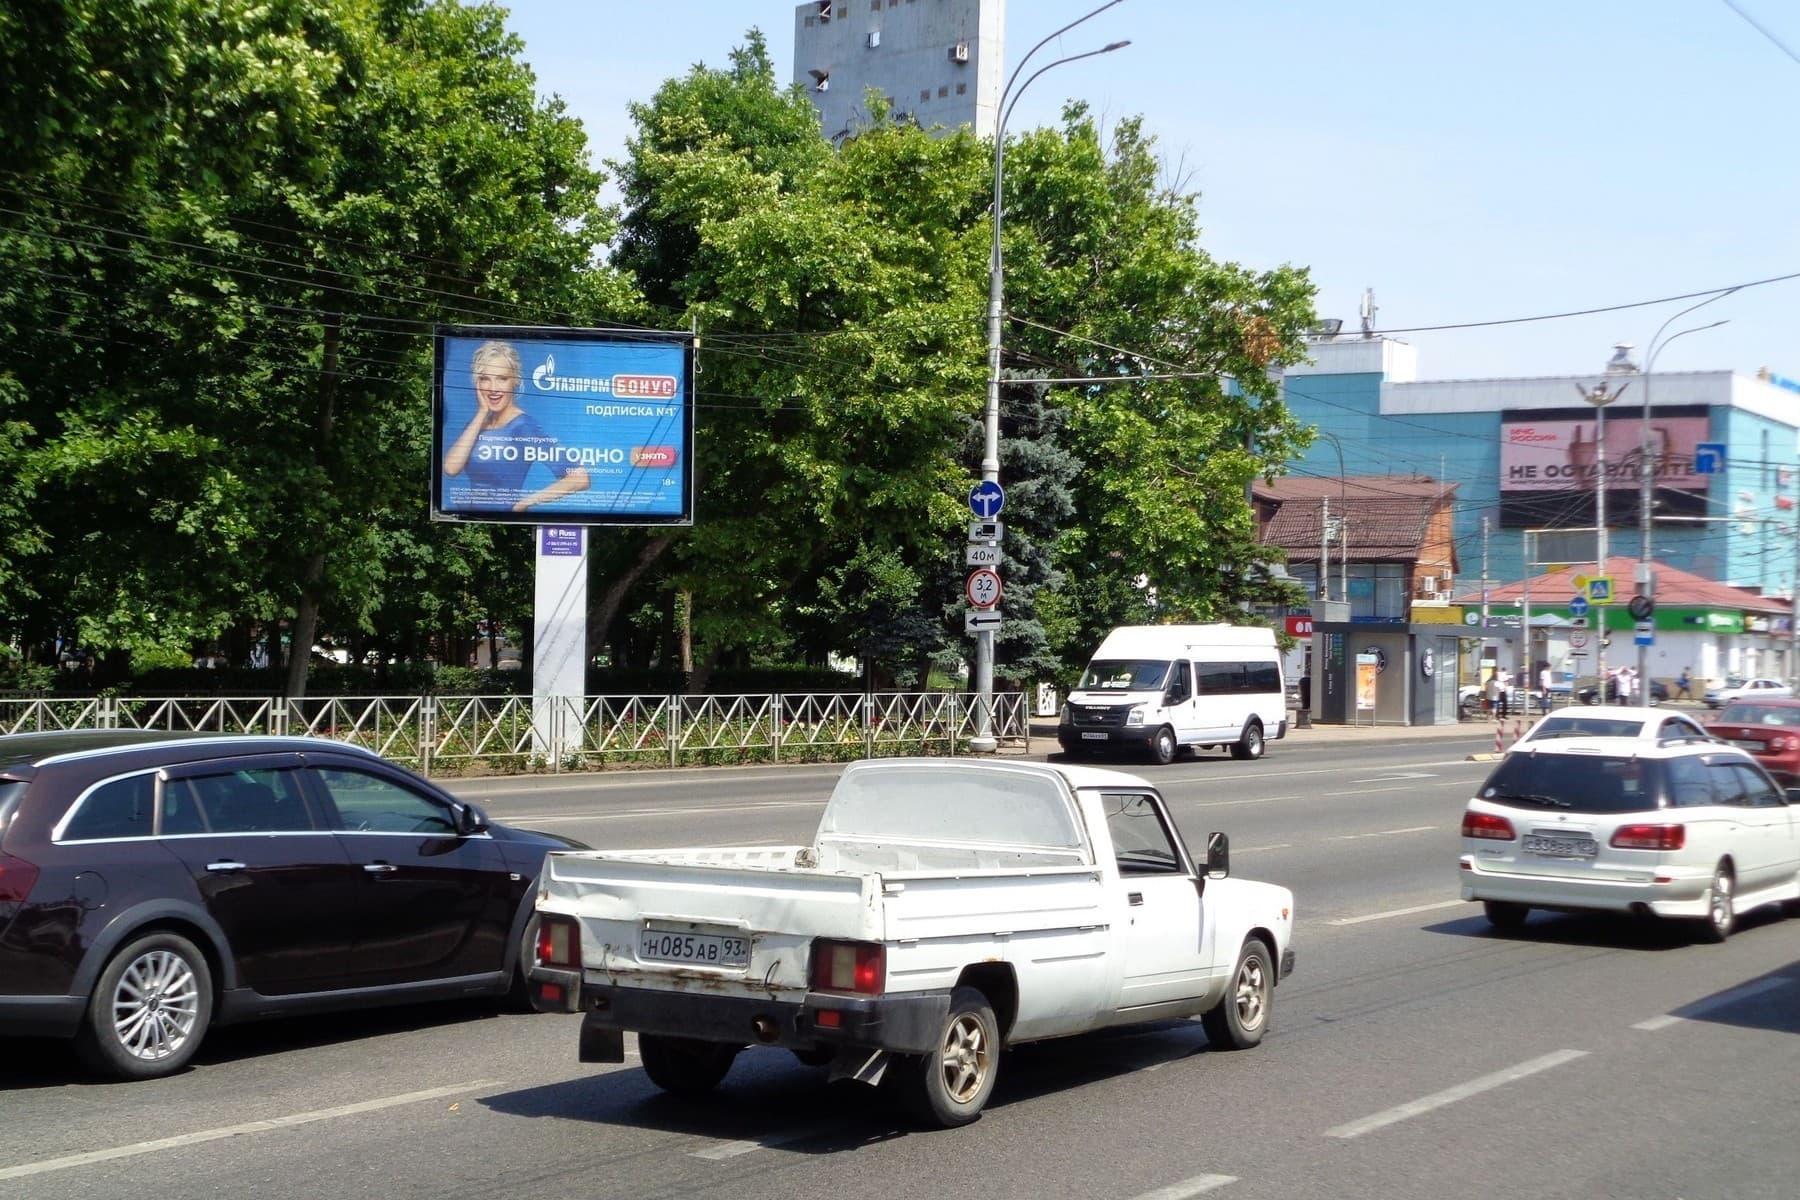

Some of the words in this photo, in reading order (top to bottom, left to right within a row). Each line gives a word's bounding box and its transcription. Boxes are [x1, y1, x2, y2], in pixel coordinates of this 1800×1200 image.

[616, 379, 672, 395] БОНУС
[585, 404, 653, 416] ПОДПИСКА
[478, 445, 518, 461] ЭТО
[524, 446, 624, 465] ВЫГОДНО
[1509, 465, 1537, 478] НЕ
[724, 940, 742, 956] 93
